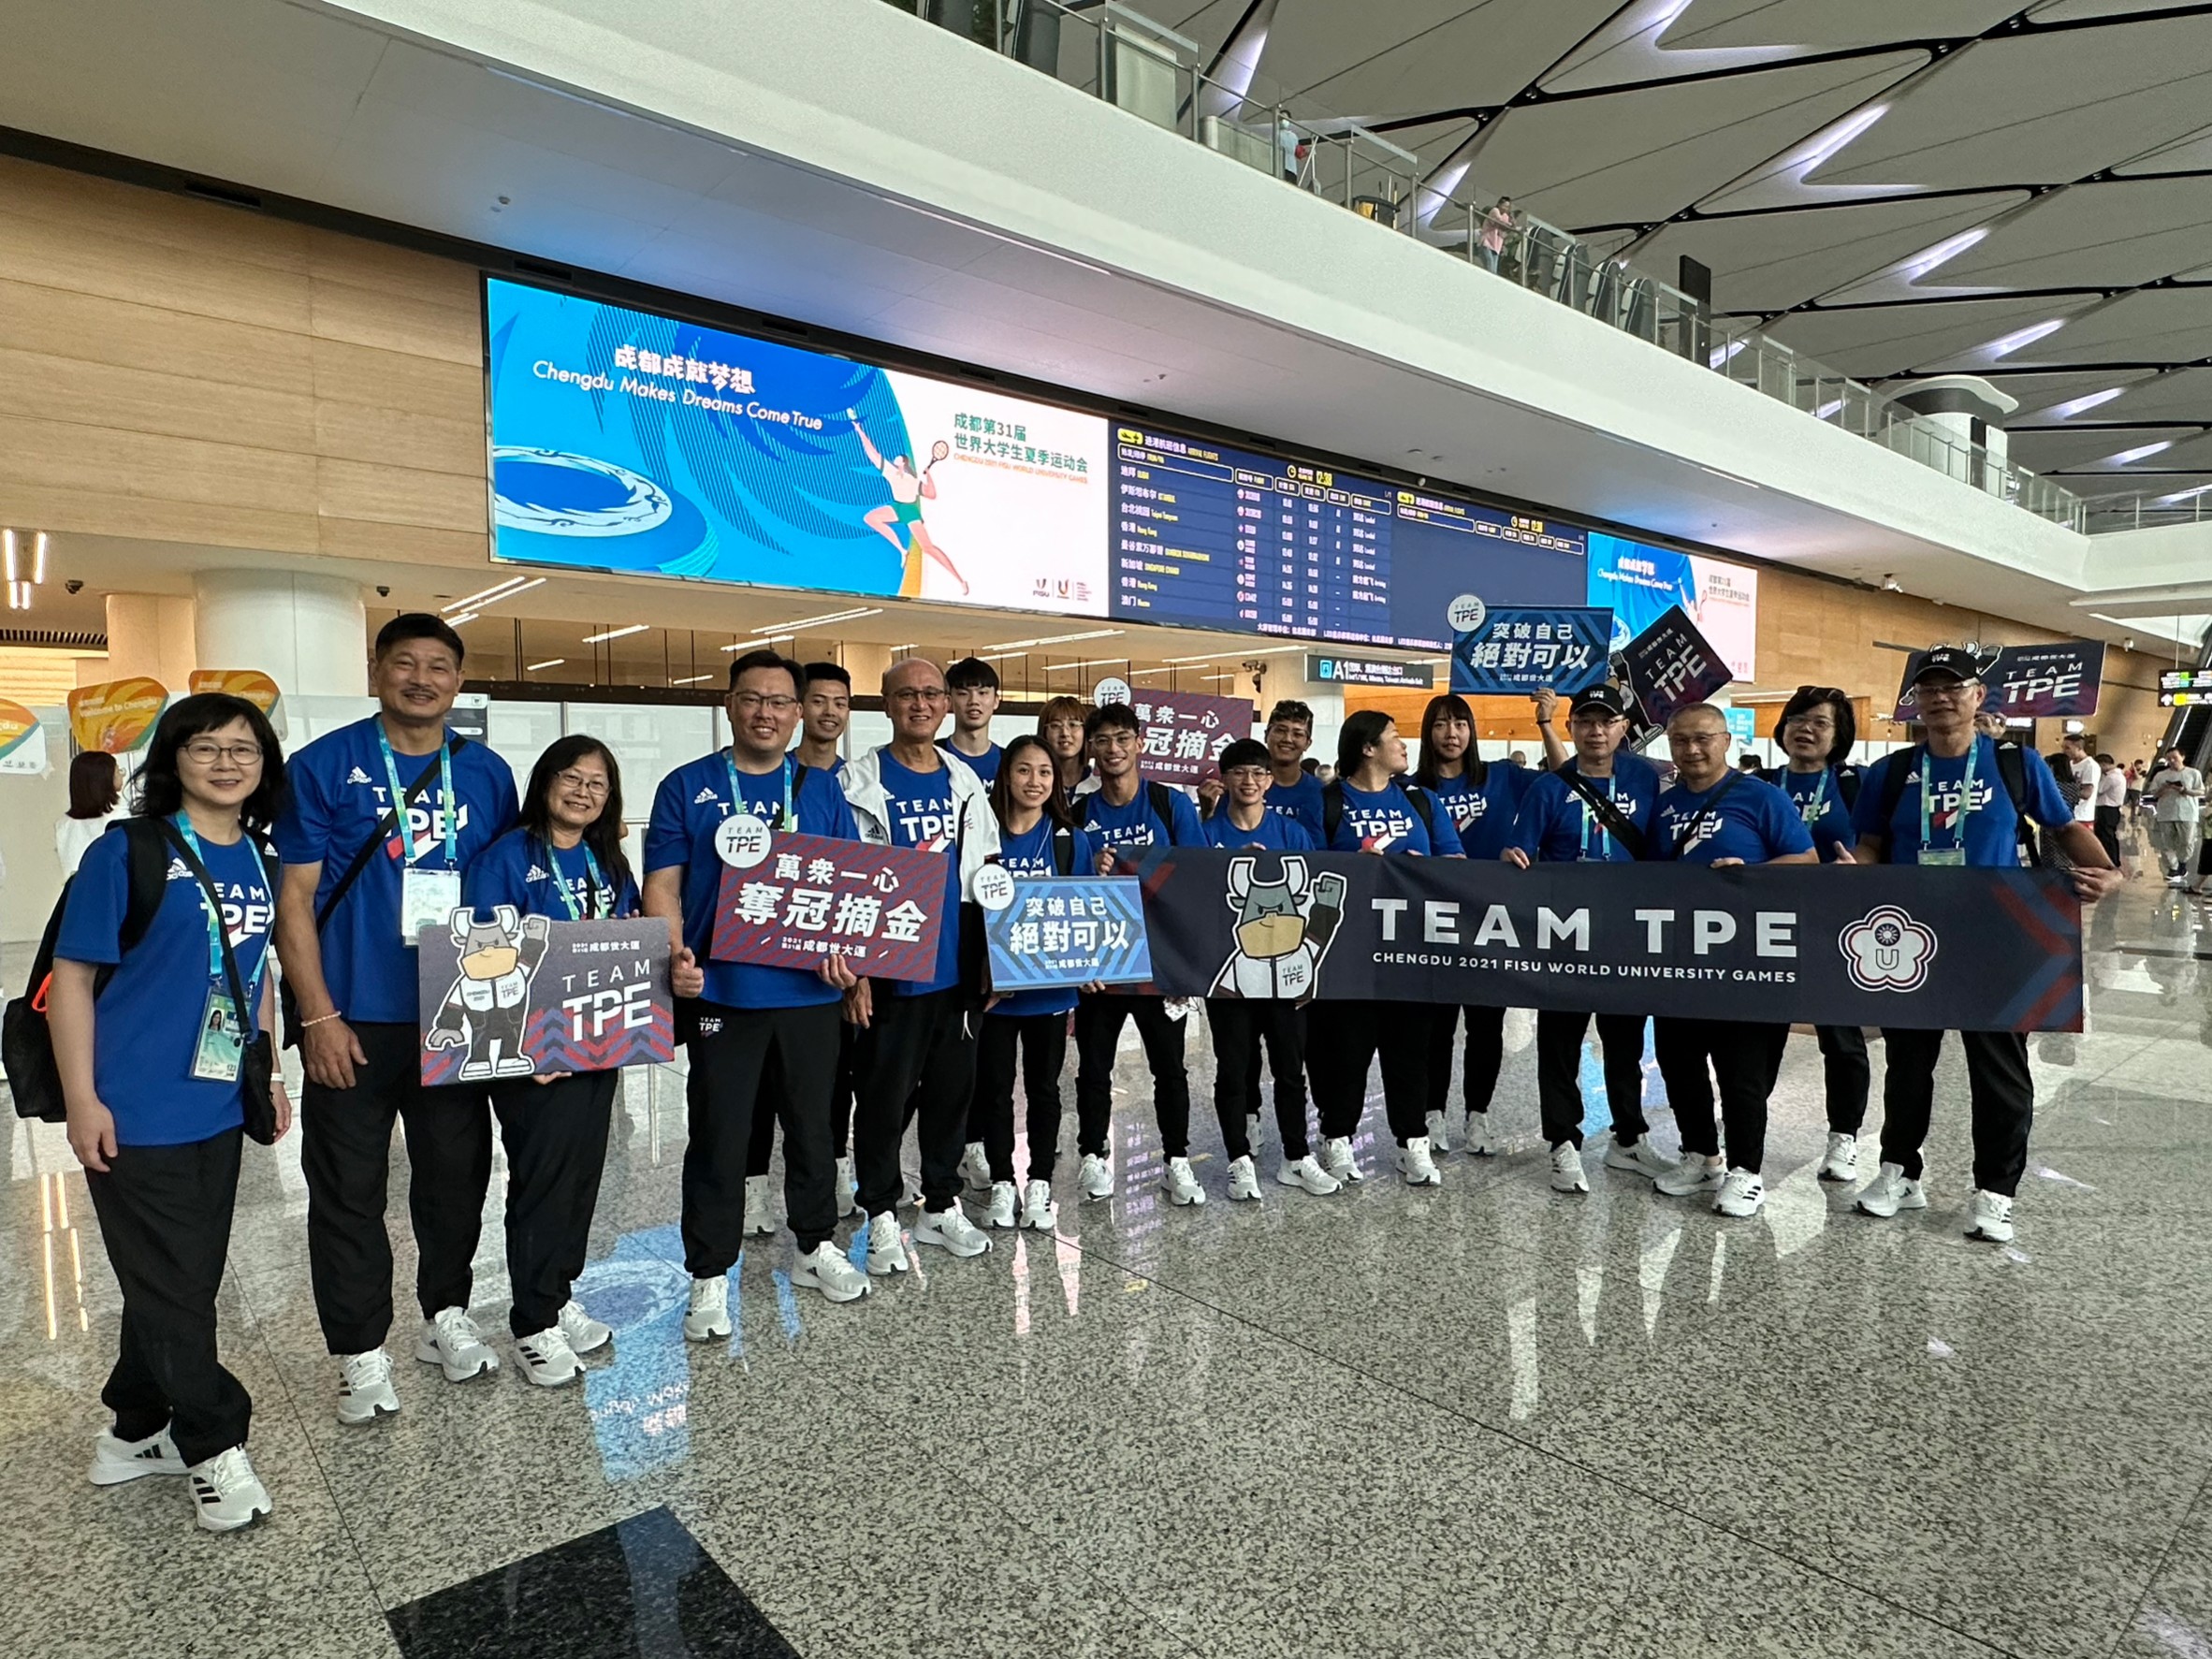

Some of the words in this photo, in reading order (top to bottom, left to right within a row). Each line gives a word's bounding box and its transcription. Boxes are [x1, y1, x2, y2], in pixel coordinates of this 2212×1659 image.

[615, 343, 756, 394] 成都成就梦想
[532, 360, 615, 391] Chengdu
[619, 376, 677, 402] Makes
[682, 389, 743, 415] Dreams
[747, 401, 791, 424] Come
[792, 411, 822, 430] True
[953, 413, 1026, 443] 成都第31届
[953, 433, 1088, 473] 世界大学生夏季运动会
[1454, 608, 1479, 623] TPE
[1492, 622, 1574, 640] 突破自己
[1469, 642, 1591, 670] 絕對可以
[1645, 633, 1688, 679] TEAM
[1332, 661, 1348, 679] A1
[1653, 645, 1707, 702] TPE
[2006, 662, 2083, 679] TEAM
[1100, 691, 1125, 705] TPE
[2002, 674, 2082, 704] TPE
[114, 704, 123, 712] to
[1139, 726, 1236, 762] 冠摘金
[1928, 779, 1984, 792] EAM
[1439, 793, 1479, 804] TEAM
[1266, 806, 1300, 815] EA
[1348, 808, 1403, 821] TEAM
[727, 826, 764, 835] TEAM
[899, 814, 955, 842] TPE
[1102, 823, 1146, 841] TEAM
[1350, 820, 1407, 838] TPE
[1670, 822, 1714, 841] TE
[726, 836, 762, 853] TPE
[997, 857, 1044, 868] TEAM
[981, 873, 1007, 882] TEAM
[981, 880, 1009, 900] TPE
[734, 880, 928, 942] 奪冠摘金
[1026, 895, 1107, 918] 突破自己
[199, 902, 269, 934] PE
[1010, 920, 1129, 954] 絕對可以
[1372, 898, 1589, 952] TEAM
[1635, 909, 1797, 958] TPE
[589, 940, 640, 952] 成都世大運
[803, 939, 866, 958] 成都世大運
[561, 958, 650, 992] TEAM
[1283, 965, 1302, 973] TEAM
[1373, 952, 1452, 968] CHENGDU
[1459, 957, 1498, 969] 2021
[1504, 960, 1542, 973] FISU
[1549, 963, 1610, 976] WORLD
[1618, 967, 1725, 982] UNIVERSITY
[1732, 970, 1797, 983] GAMES
[1283, 970, 1304, 986] TPE
[502, 986, 519, 998] TPE
[562, 981, 653, 1042] TPE
[699, 1022, 720, 1032] TPE
